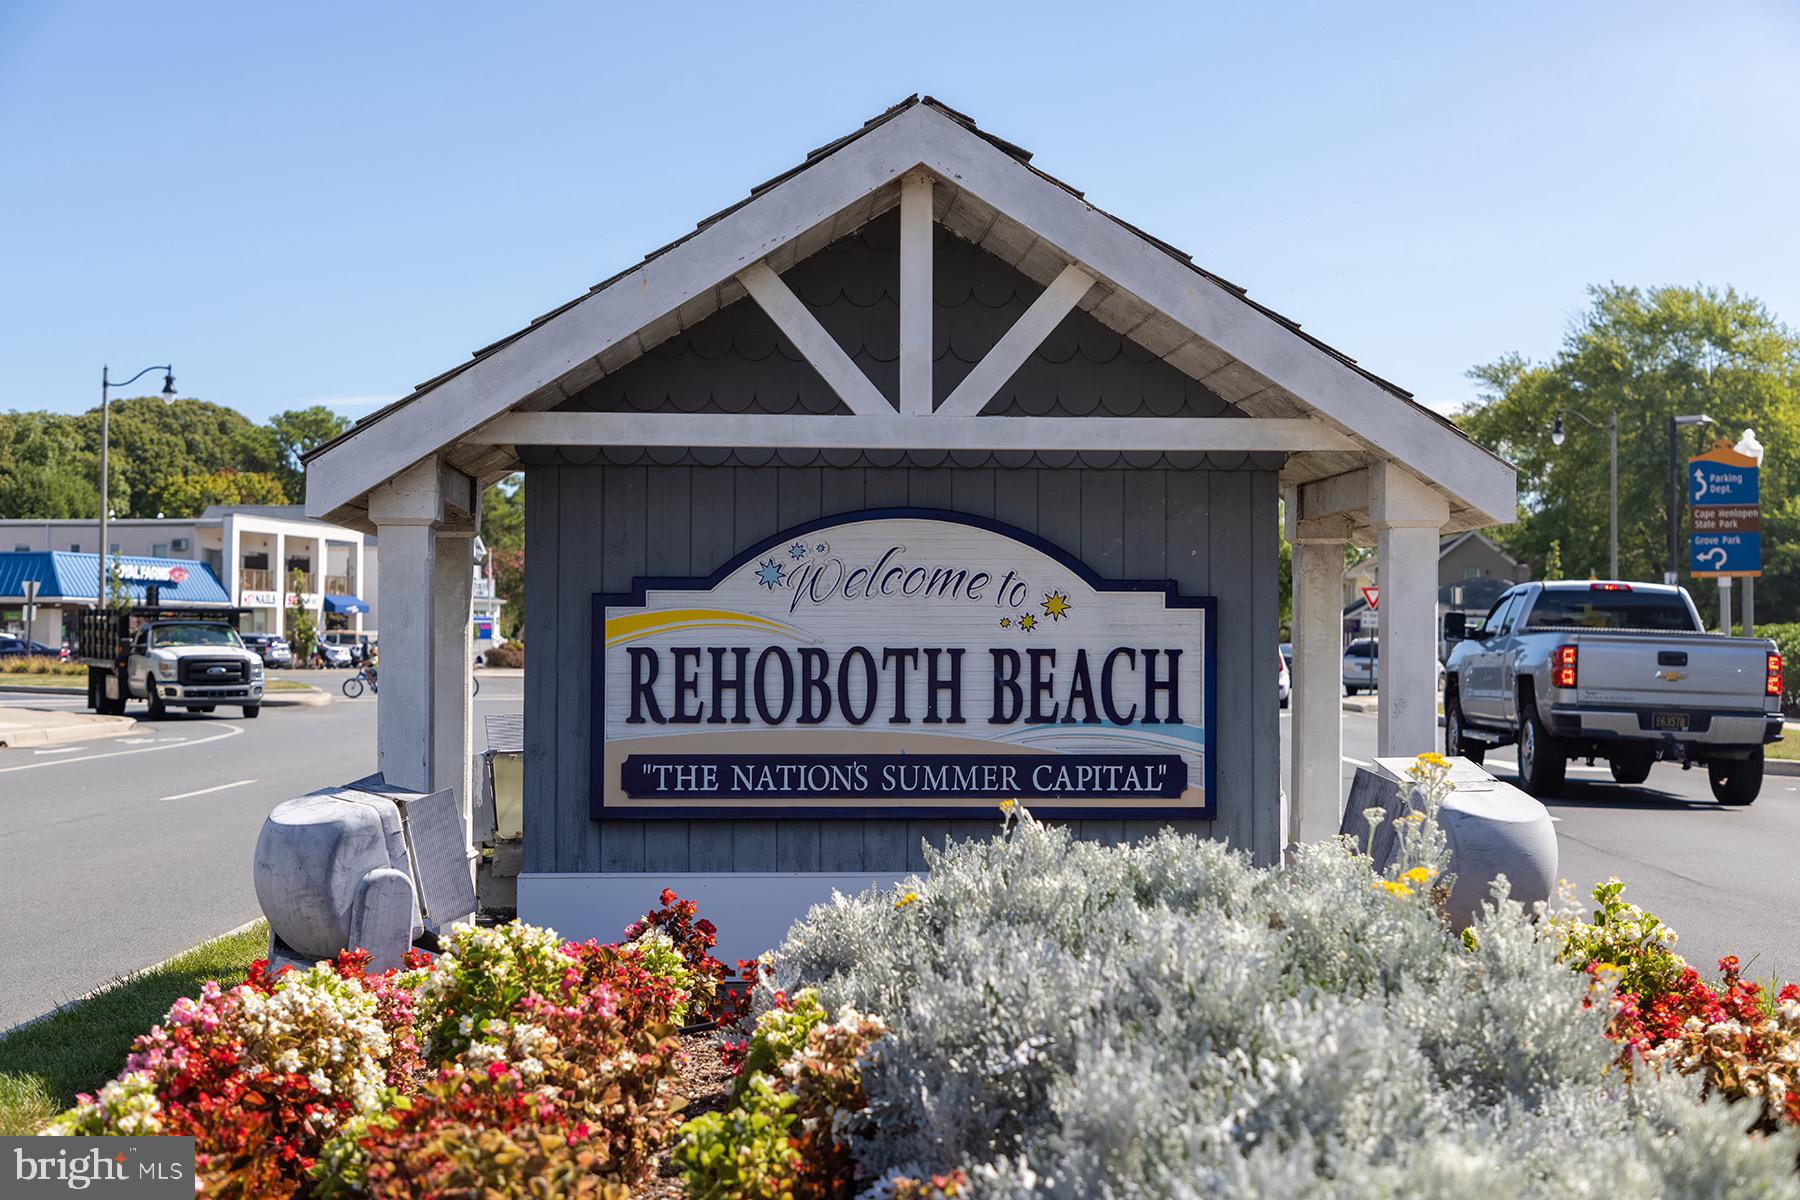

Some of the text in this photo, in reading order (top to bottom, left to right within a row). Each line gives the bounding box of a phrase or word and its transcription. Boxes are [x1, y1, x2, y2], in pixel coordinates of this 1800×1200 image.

[1710, 473, 1743, 484] Parking
[1710, 484, 1732, 495] Dept.
[1694, 508, 1759, 519] Cape Henlopen
[1694, 518, 1738, 529] State Park
[1694, 535, 1741, 545] Grove Park
[788, 545, 1028, 614] Welcome to
[625, 645, 1184, 726] REHOBOTH BEACH
[642, 761, 1168, 792] "THE NATION'S SUMMER CAPITAL"
